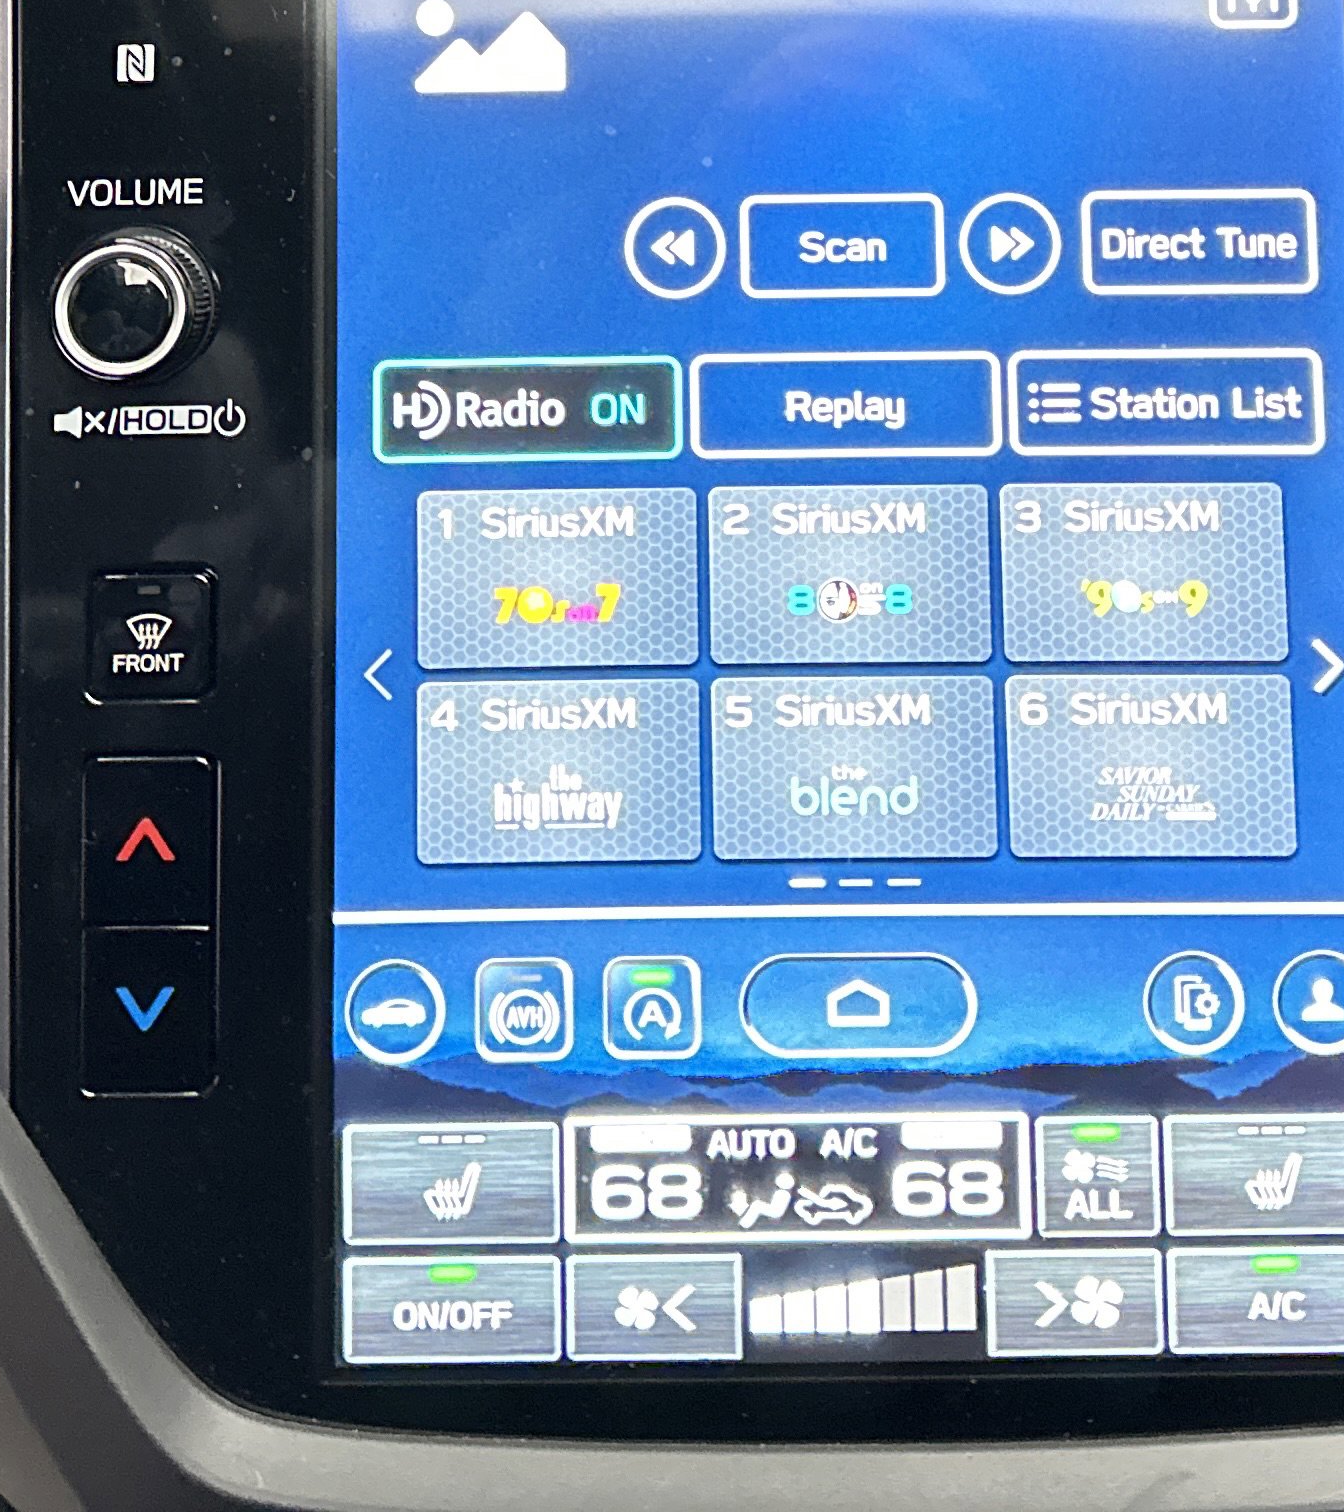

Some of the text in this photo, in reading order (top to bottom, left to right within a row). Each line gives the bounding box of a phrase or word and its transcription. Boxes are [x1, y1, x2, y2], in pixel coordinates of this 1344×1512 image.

[67, 177, 204, 207] VOLUME
[798, 231, 887, 264] Scan
[1101, 226, 1298, 260] Direct Tune
[457, 388, 566, 429] Radio
[590, 393, 646, 426] ON
[785, 390, 905, 430] Replay
[1090, 386, 1303, 421] Station List
[437, 505, 635, 540] 1 SiriusXM
[722, 502, 926, 536] 2 SiriusXM
[1014, 499, 1220, 534] 3 SiriusXM
[112, 652, 185, 674] FRONT
[430, 697, 636, 732] 4 SiriusXM
[725, 693, 931, 728] 5 SiriusXM
[1019, 691, 1227, 726] 6 SiriusXM
[549, 764, 583, 791] the
[831, 764, 867, 781] the
[1097, 766, 1173, 785] SAVIOR
[493, 782, 623, 830] highway
[790, 774, 919, 817] blend
[1117, 784, 1201, 803] SUNDAY
[1090, 802, 1157, 821] DAILY
[707, 1127, 878, 1161] AUTO A/C
[590, 1163, 703, 1222] 68
[891, 1159, 1005, 1219] 68
[1063, 1189, 1134, 1221] ALL
[392, 1300, 514, 1332] ON/OFF
[1247, 1291, 1307, 1322] A/C
